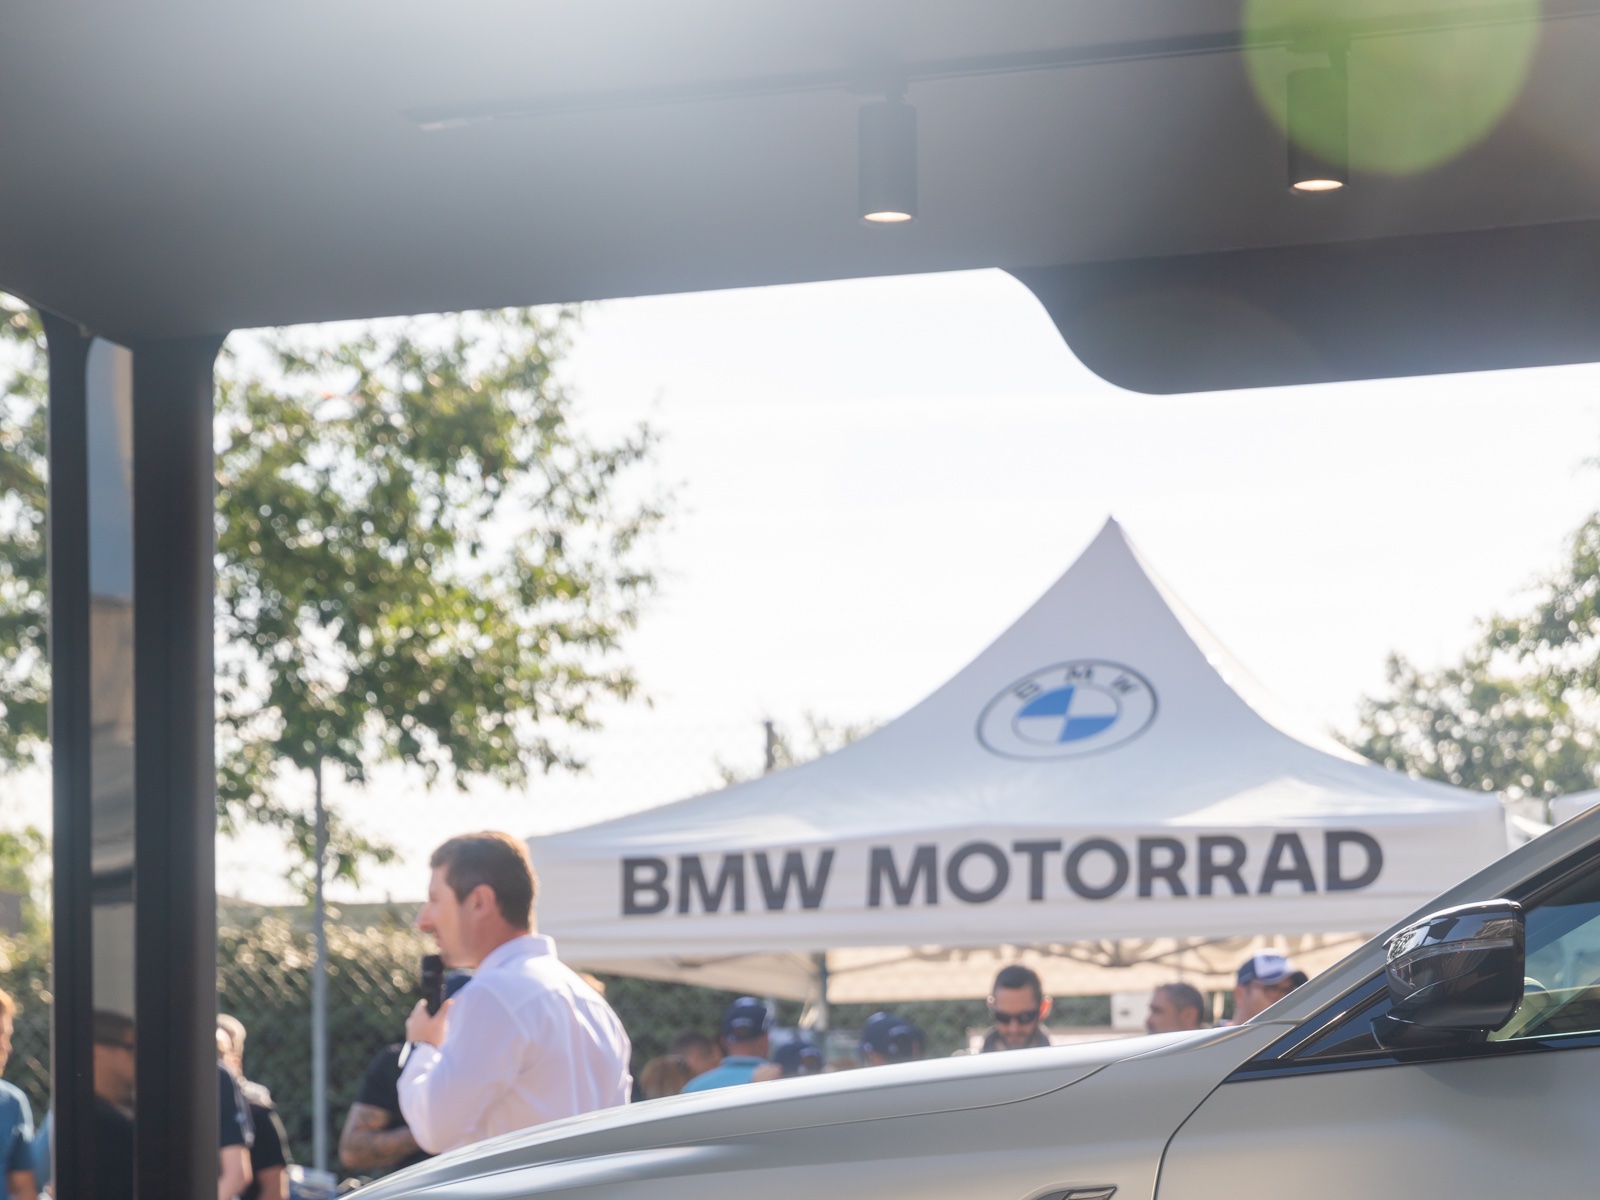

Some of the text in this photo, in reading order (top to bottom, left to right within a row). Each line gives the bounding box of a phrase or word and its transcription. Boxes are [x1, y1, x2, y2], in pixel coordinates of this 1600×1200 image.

[1013, 665, 1138, 699] BMW
[621, 830, 1384, 916] BMW MOTORRAD
